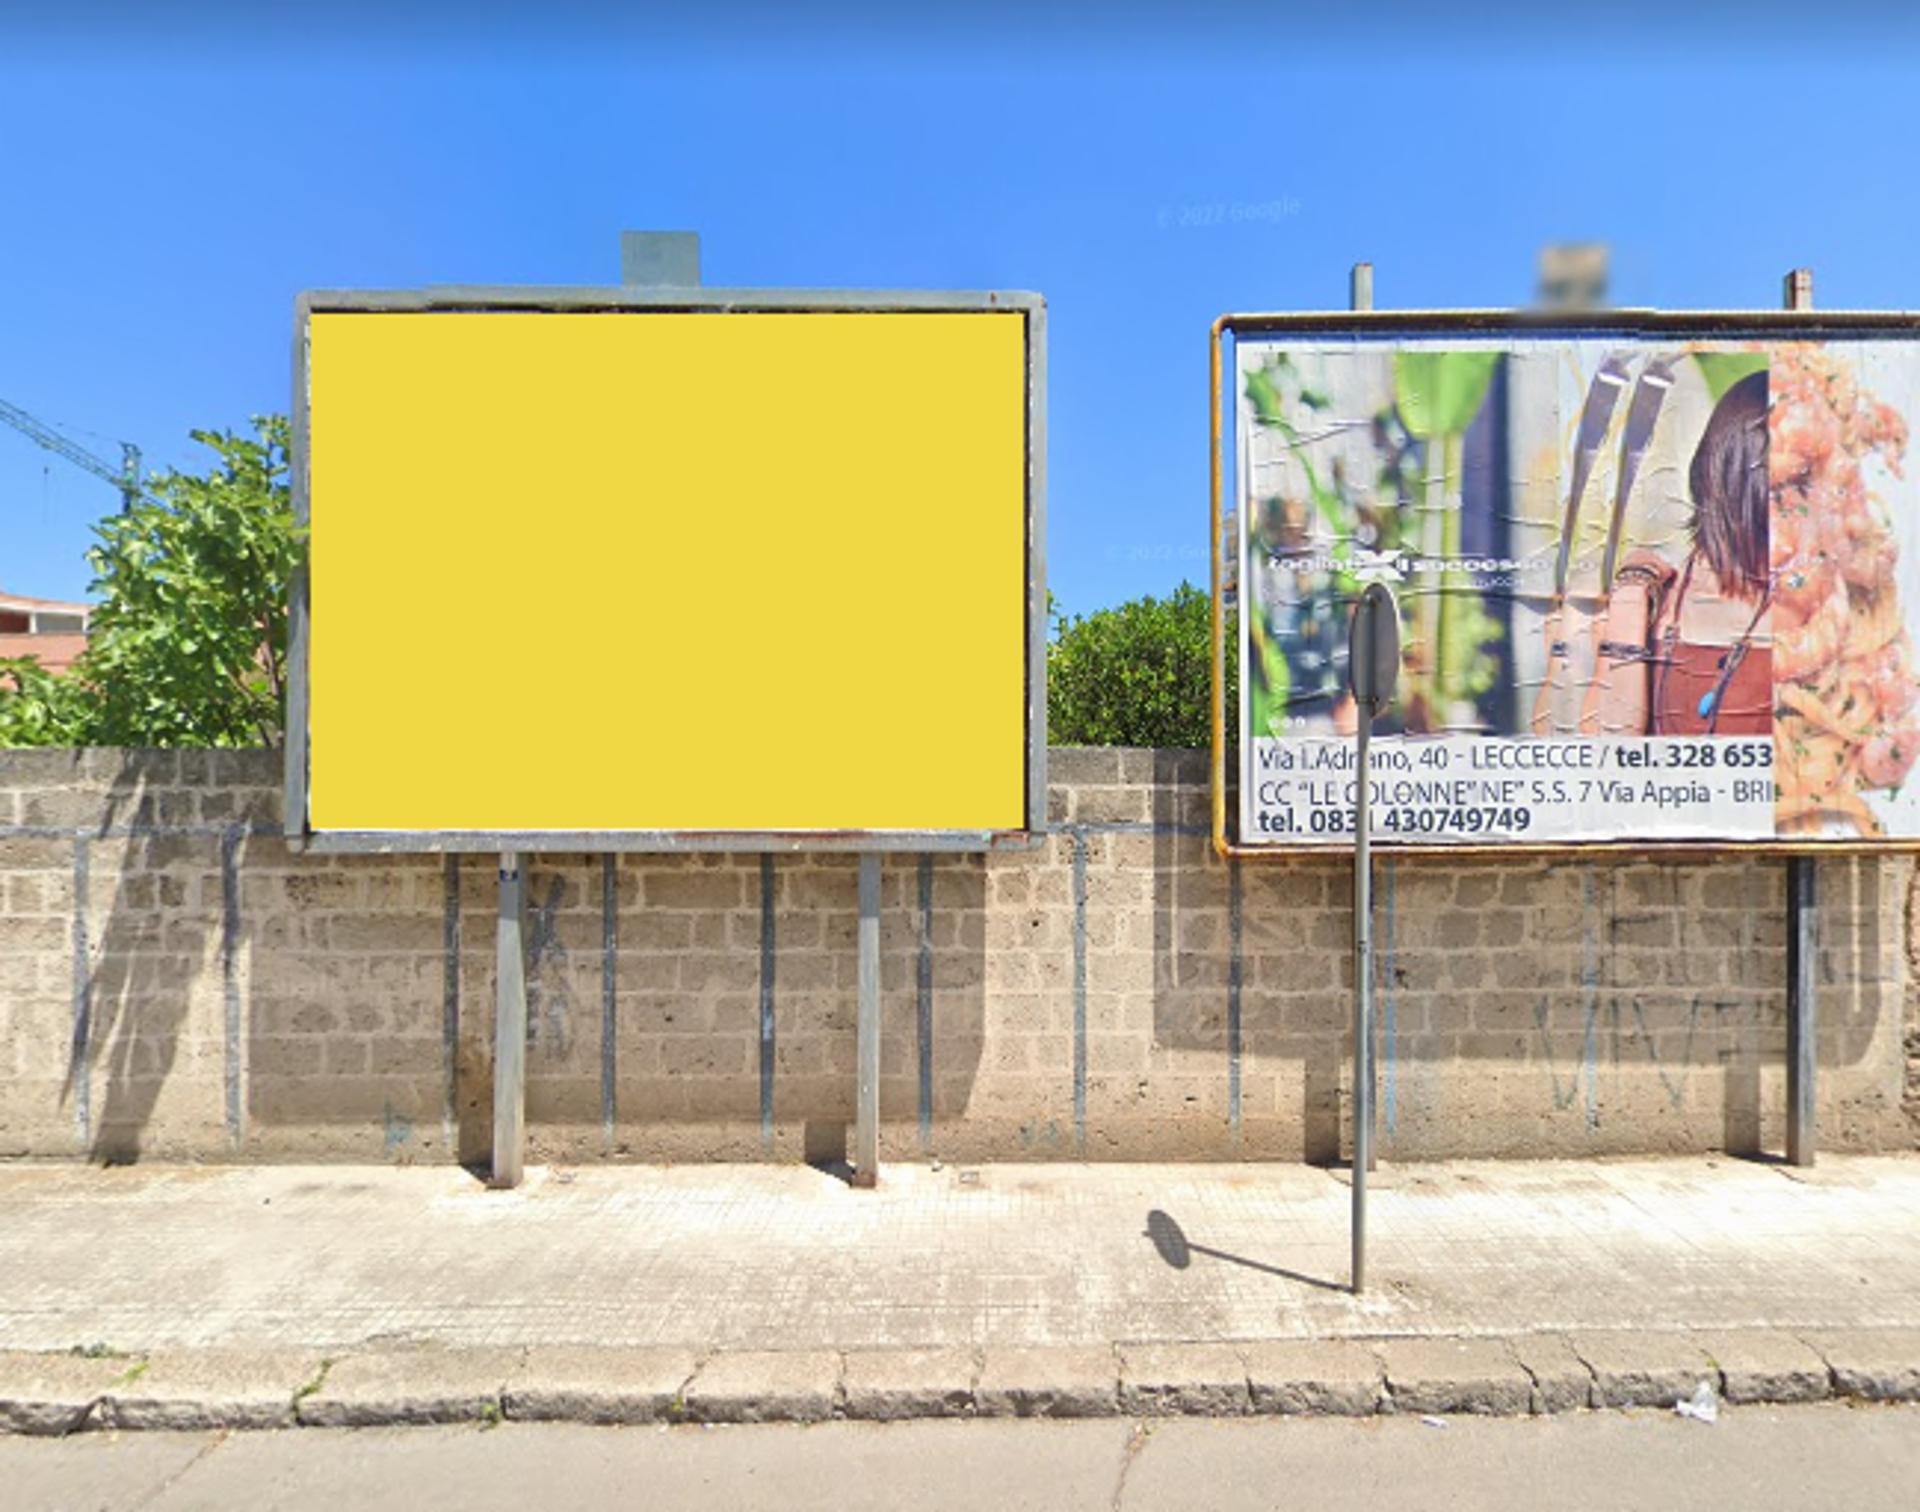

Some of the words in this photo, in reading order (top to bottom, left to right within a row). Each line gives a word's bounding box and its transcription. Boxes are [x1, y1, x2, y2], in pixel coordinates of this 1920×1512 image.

[1259, 746, 1294, 769] Via
[1418, 747, 1448, 769] 40
[1472, 745, 1593, 769] LECCECCE
[1613, 743, 1660, 768] tel.
[1665, 745, 1716, 768] 328
[1723, 745, 1774, 768] 653
[1258, 780, 1294, 805] CC
[1531, 780, 1573, 803] S.S.
[1579, 780, 1593, 802] 7
[1597, 780, 1634, 803] Via
[1641, 780, 1711, 808] Appia
[1257, 807, 1303, 833] tel.
